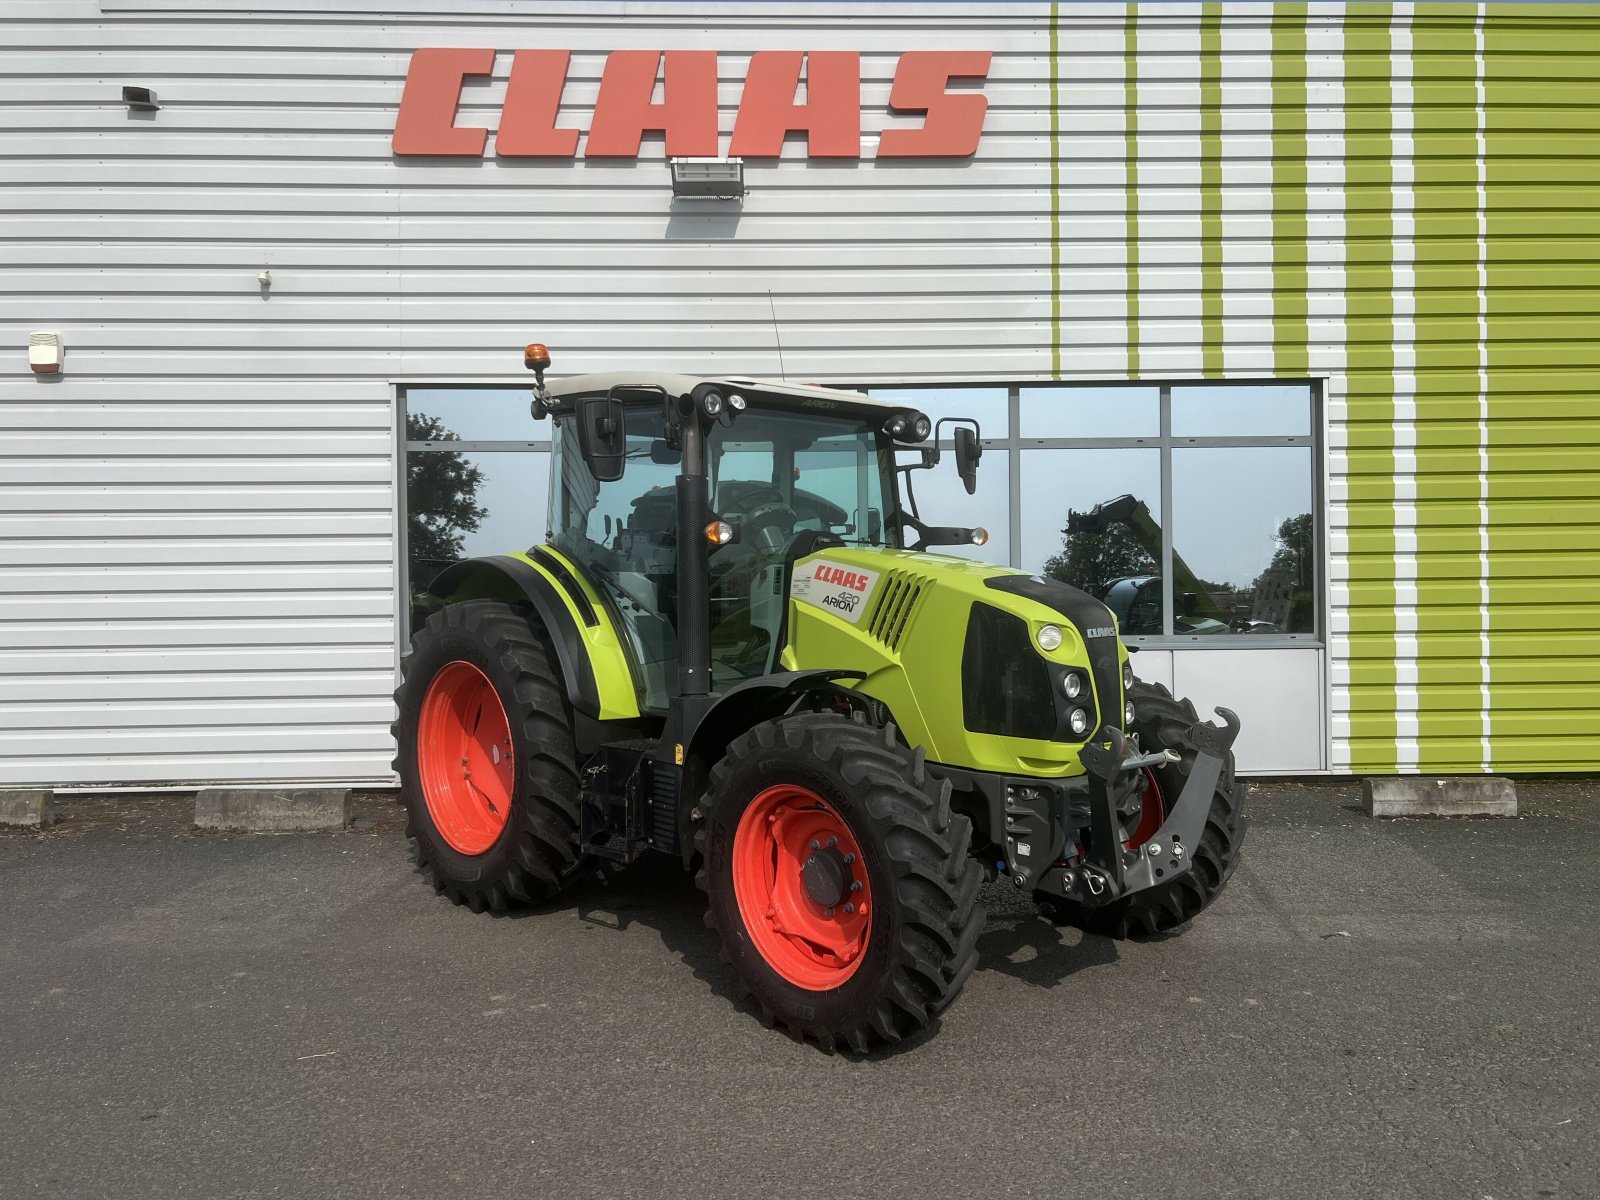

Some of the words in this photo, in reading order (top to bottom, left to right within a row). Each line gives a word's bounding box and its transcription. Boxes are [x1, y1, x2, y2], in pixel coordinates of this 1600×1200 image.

[392, 48, 993, 158] CLAAS
[814, 564, 869, 592] CLAAS
[822, 595, 855, 613] ARION
[838, 591, 860, 605] 420
[1087, 627, 1116, 639] CLAAS
